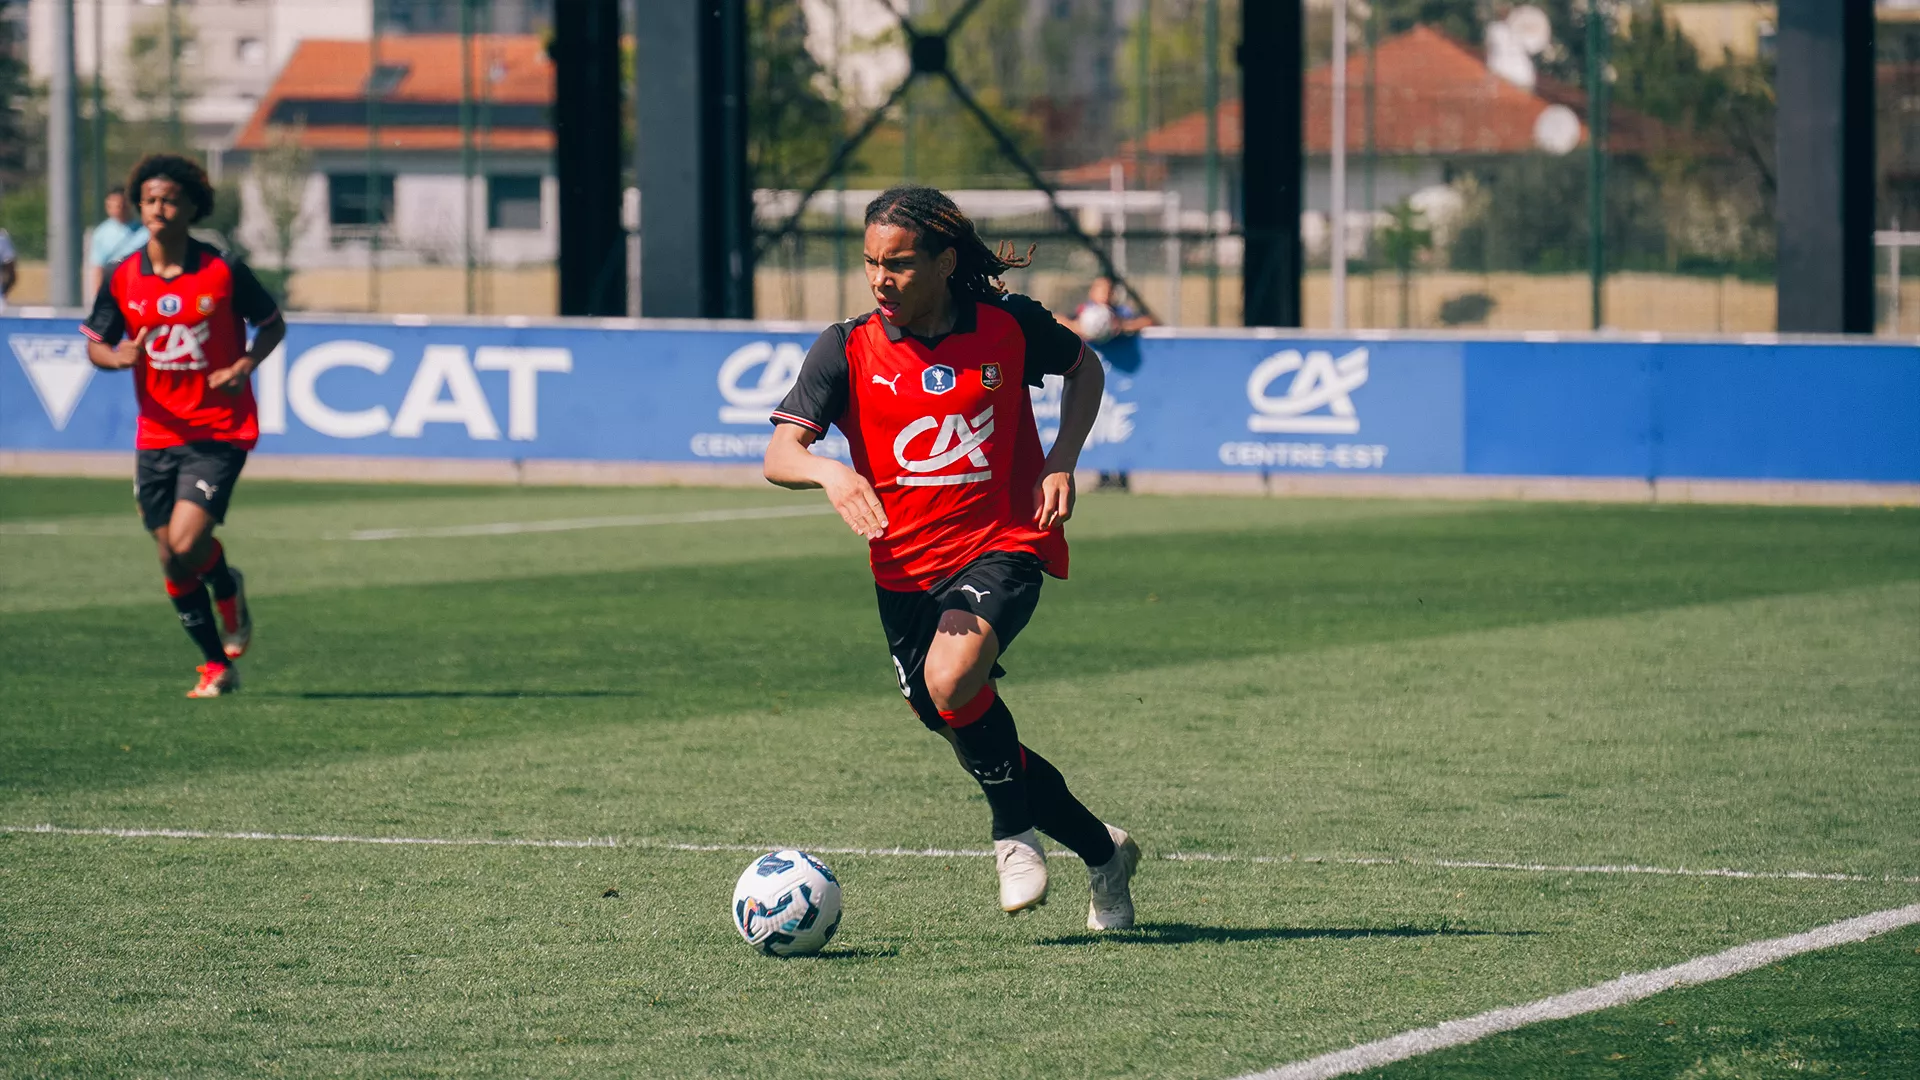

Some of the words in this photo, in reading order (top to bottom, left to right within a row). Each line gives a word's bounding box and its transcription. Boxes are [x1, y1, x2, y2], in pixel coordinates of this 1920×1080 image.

[14, 335, 92, 363] VICA
[256, 339, 572, 441] ICAT
[893, 405, 995, 473] CA
[1219, 441, 1389, 468] CENTRE-EST
